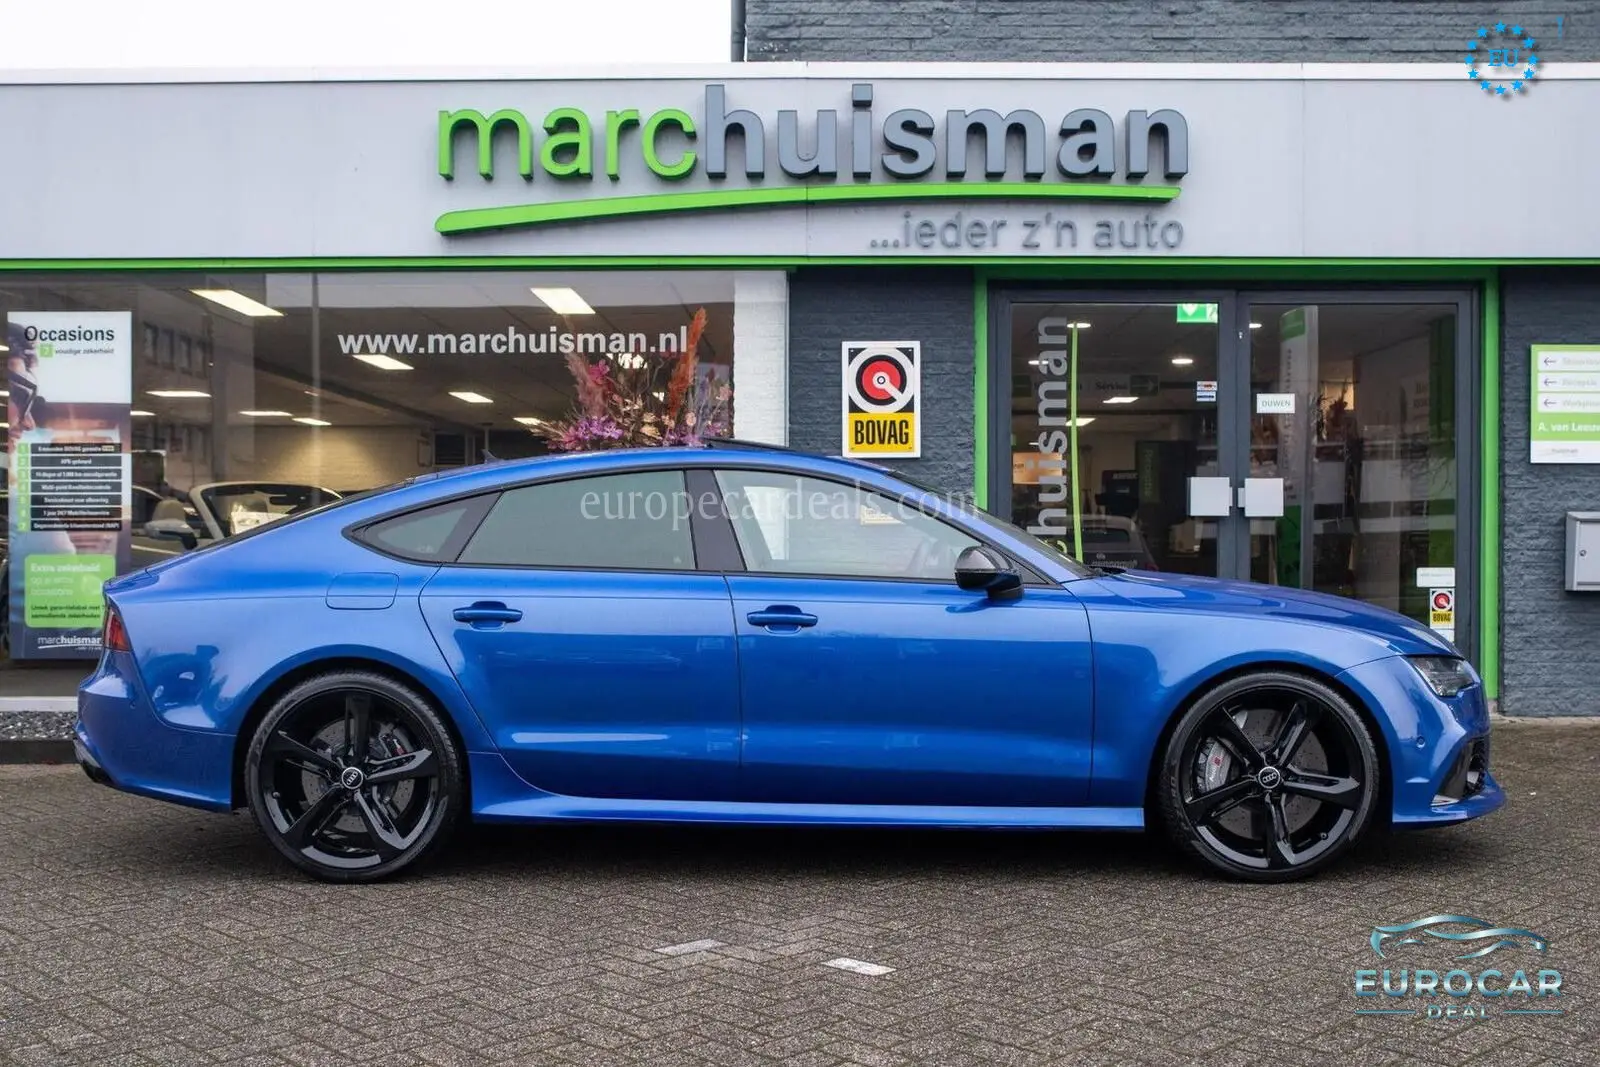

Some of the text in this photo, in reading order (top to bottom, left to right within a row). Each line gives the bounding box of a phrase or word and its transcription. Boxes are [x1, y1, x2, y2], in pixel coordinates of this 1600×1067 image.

[438, 83, 1190, 181] marchuisman
[870, 212, 1185, 249] ...ieder z'n auto
[24, 325, 115, 342] Occasions
[338, 326, 688, 353] www.marchuisman.nl
[1261, 400, 1291, 408] DUWEN
[854, 419, 909, 445] BOVAG
